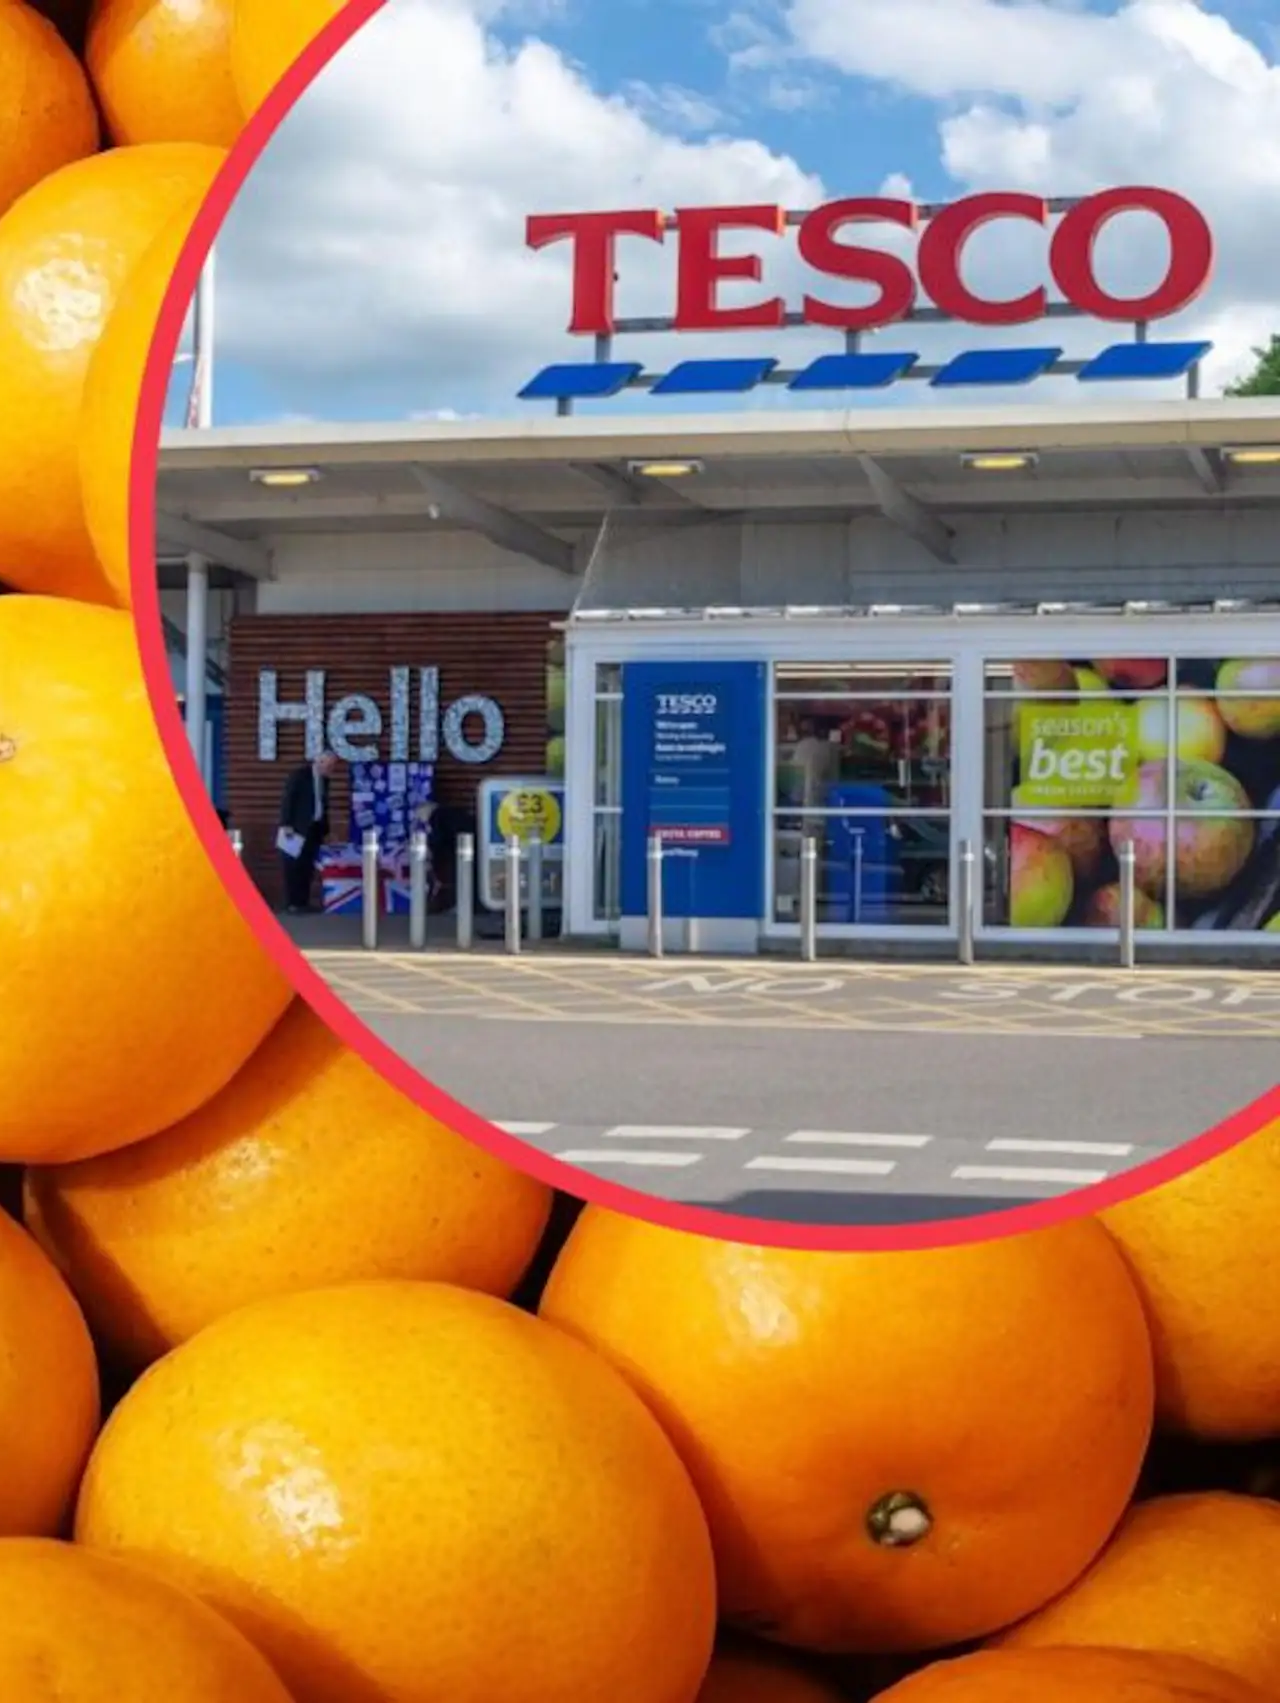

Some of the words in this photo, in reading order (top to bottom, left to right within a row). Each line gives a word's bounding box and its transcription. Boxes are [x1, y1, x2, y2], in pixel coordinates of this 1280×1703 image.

[526, 186, 1214, 334] TESCO
[258, 665, 505, 763] Hello
[655, 694, 717, 708] TESCO
[1030, 710, 1130, 737] season's
[1029, 738, 1128, 780] best
[636, 973, 845, 995] NO
